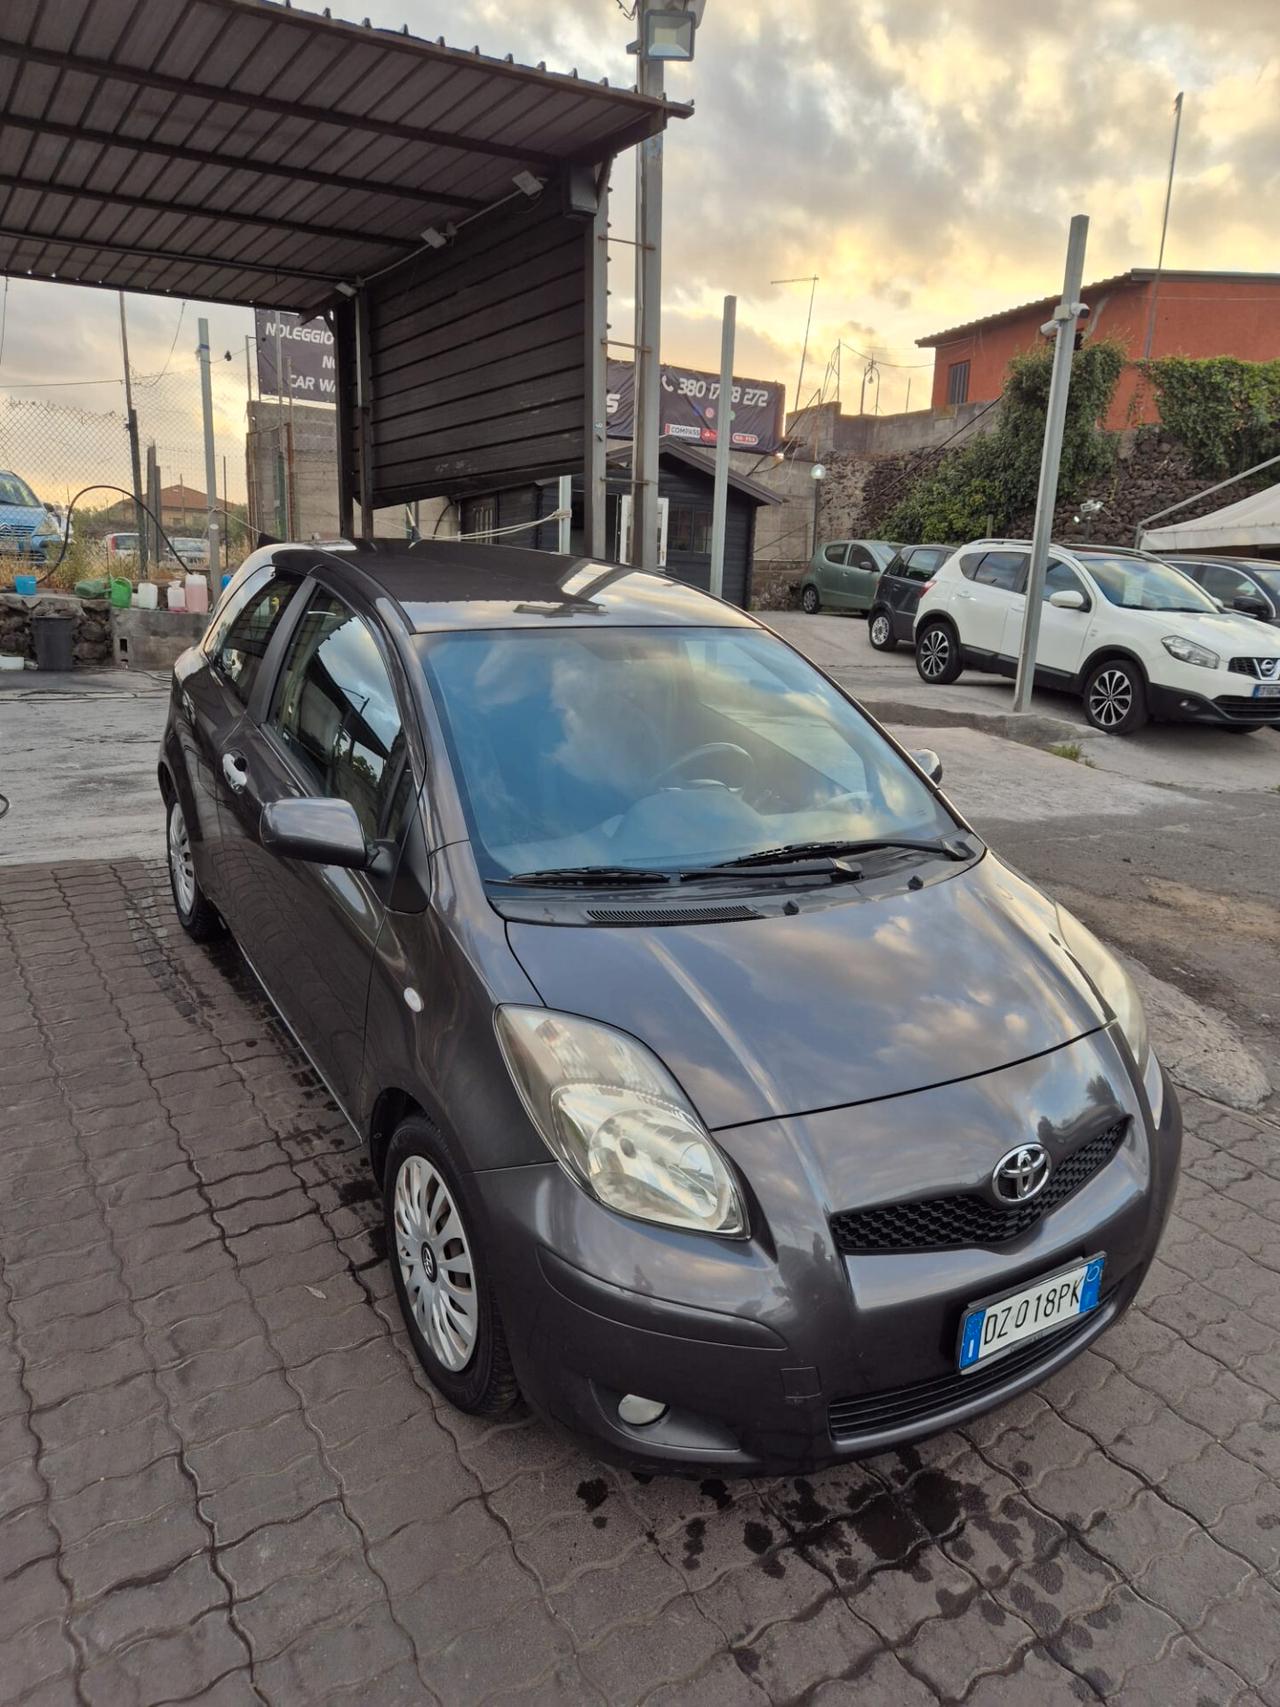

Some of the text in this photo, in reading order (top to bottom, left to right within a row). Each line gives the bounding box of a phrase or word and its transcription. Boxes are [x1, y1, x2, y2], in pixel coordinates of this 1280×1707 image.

[677, 377, 768, 407] 380 178 272
[983, 1275, 1084, 1346] DZ018PK
